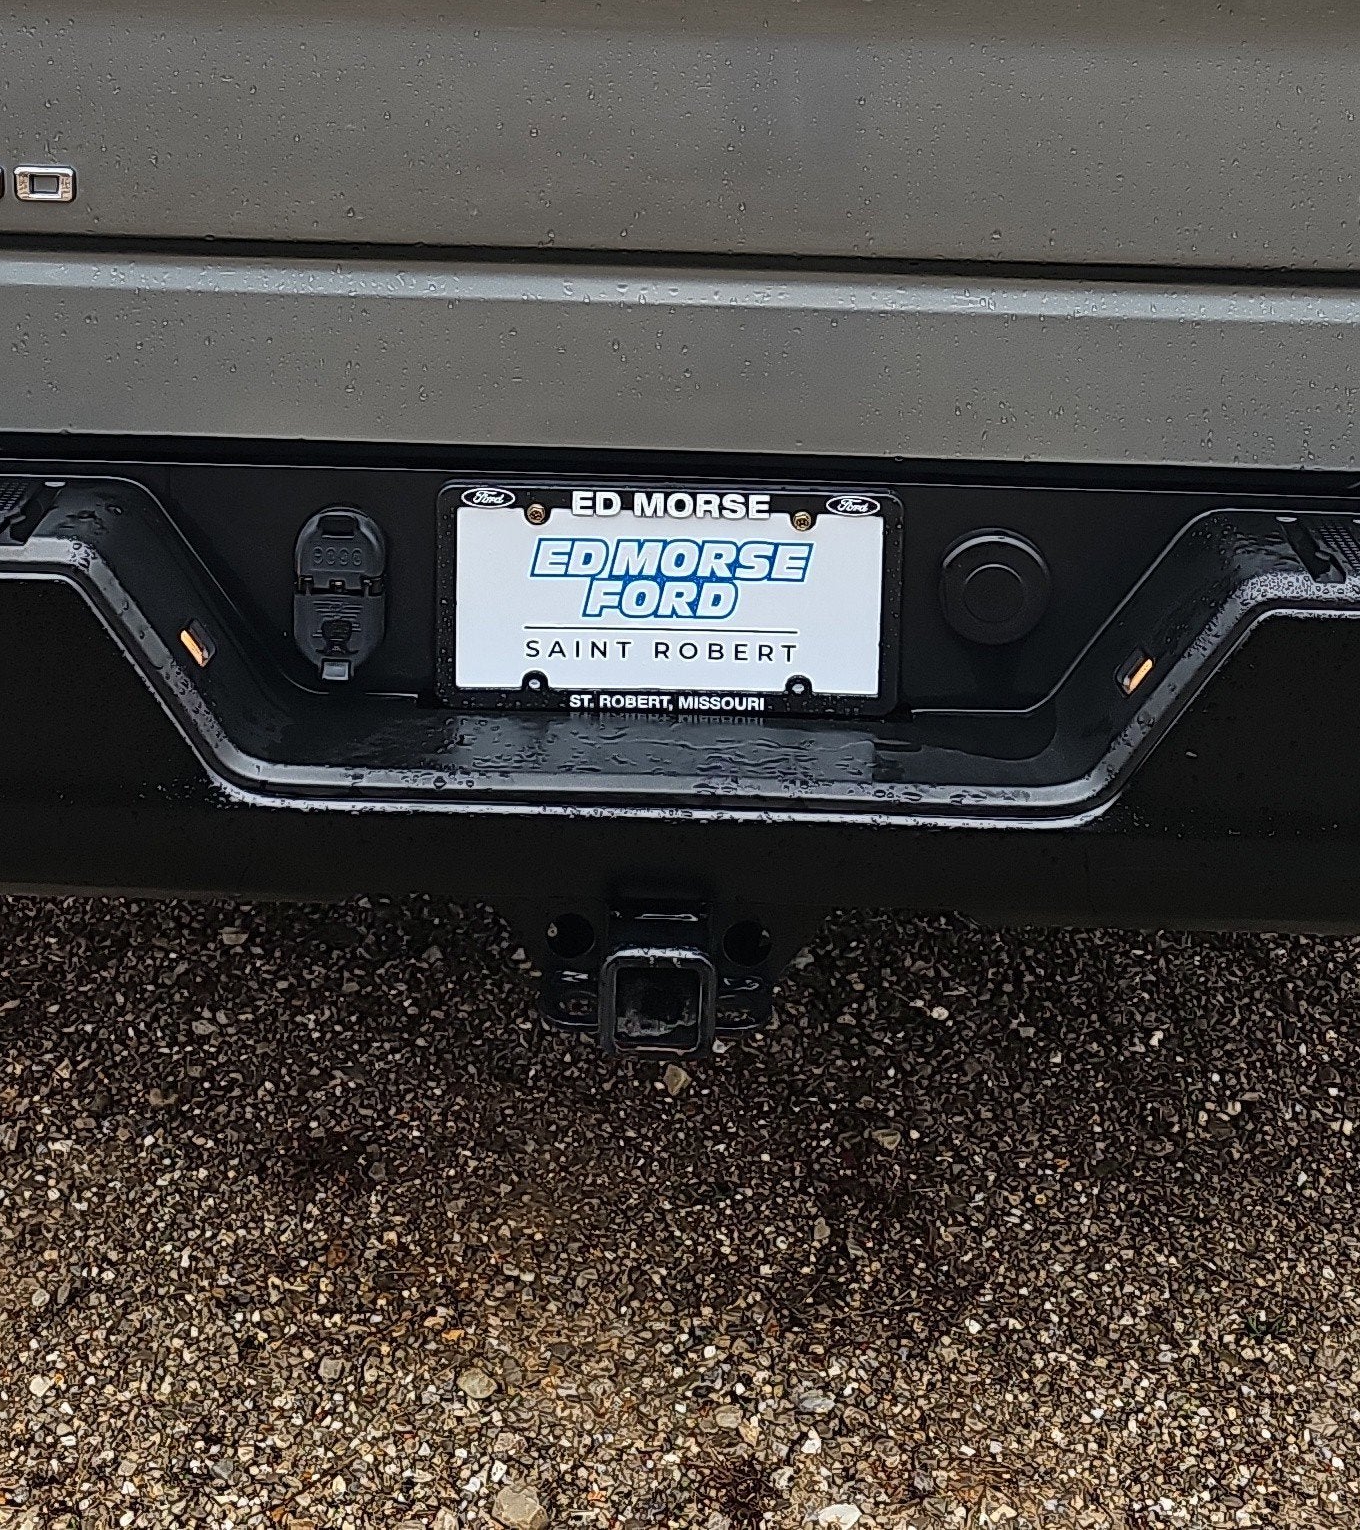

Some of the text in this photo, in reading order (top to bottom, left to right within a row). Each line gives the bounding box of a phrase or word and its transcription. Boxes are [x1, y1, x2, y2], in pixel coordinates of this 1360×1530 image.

[472, 489, 506, 506] Ford
[572, 491, 771, 520] ED MORSE
[837, 497, 871, 514] Ford
[530, 537, 814, 582] ED MORSE
[582, 578, 739, 619] FORD
[525, 639, 797, 663] SAINT ROBERT
[569, 694, 765, 711] ST. ROBERT, MISSOURI
